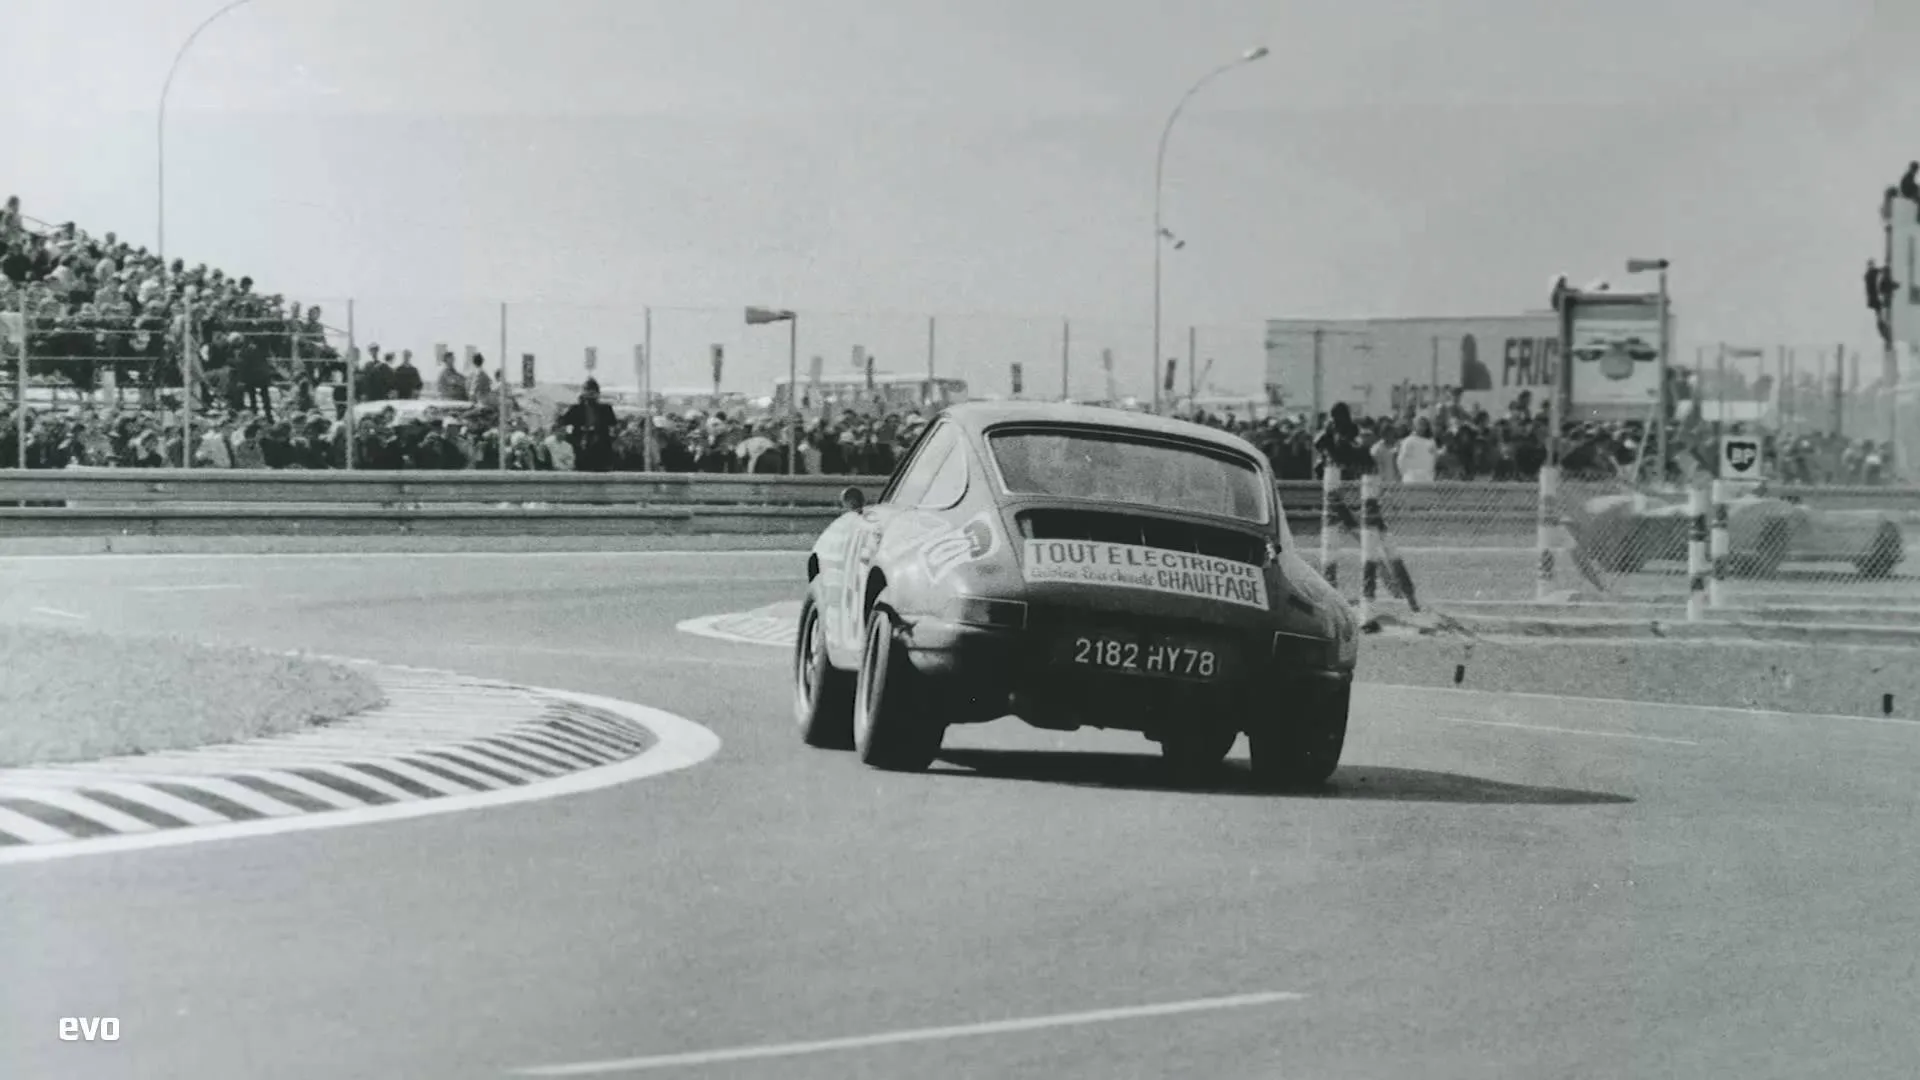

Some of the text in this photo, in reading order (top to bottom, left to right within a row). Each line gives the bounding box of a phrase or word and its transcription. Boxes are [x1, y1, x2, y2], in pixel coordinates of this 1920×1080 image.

[1731, 447, 1756, 465] BP
[1030, 542, 1099, 564] TOUT
[1107, 546, 1257, 578] ELECTRIQUE
[1157, 570, 1262, 605] CHAUFFAGE
[1074, 637, 1139, 668] 2182
